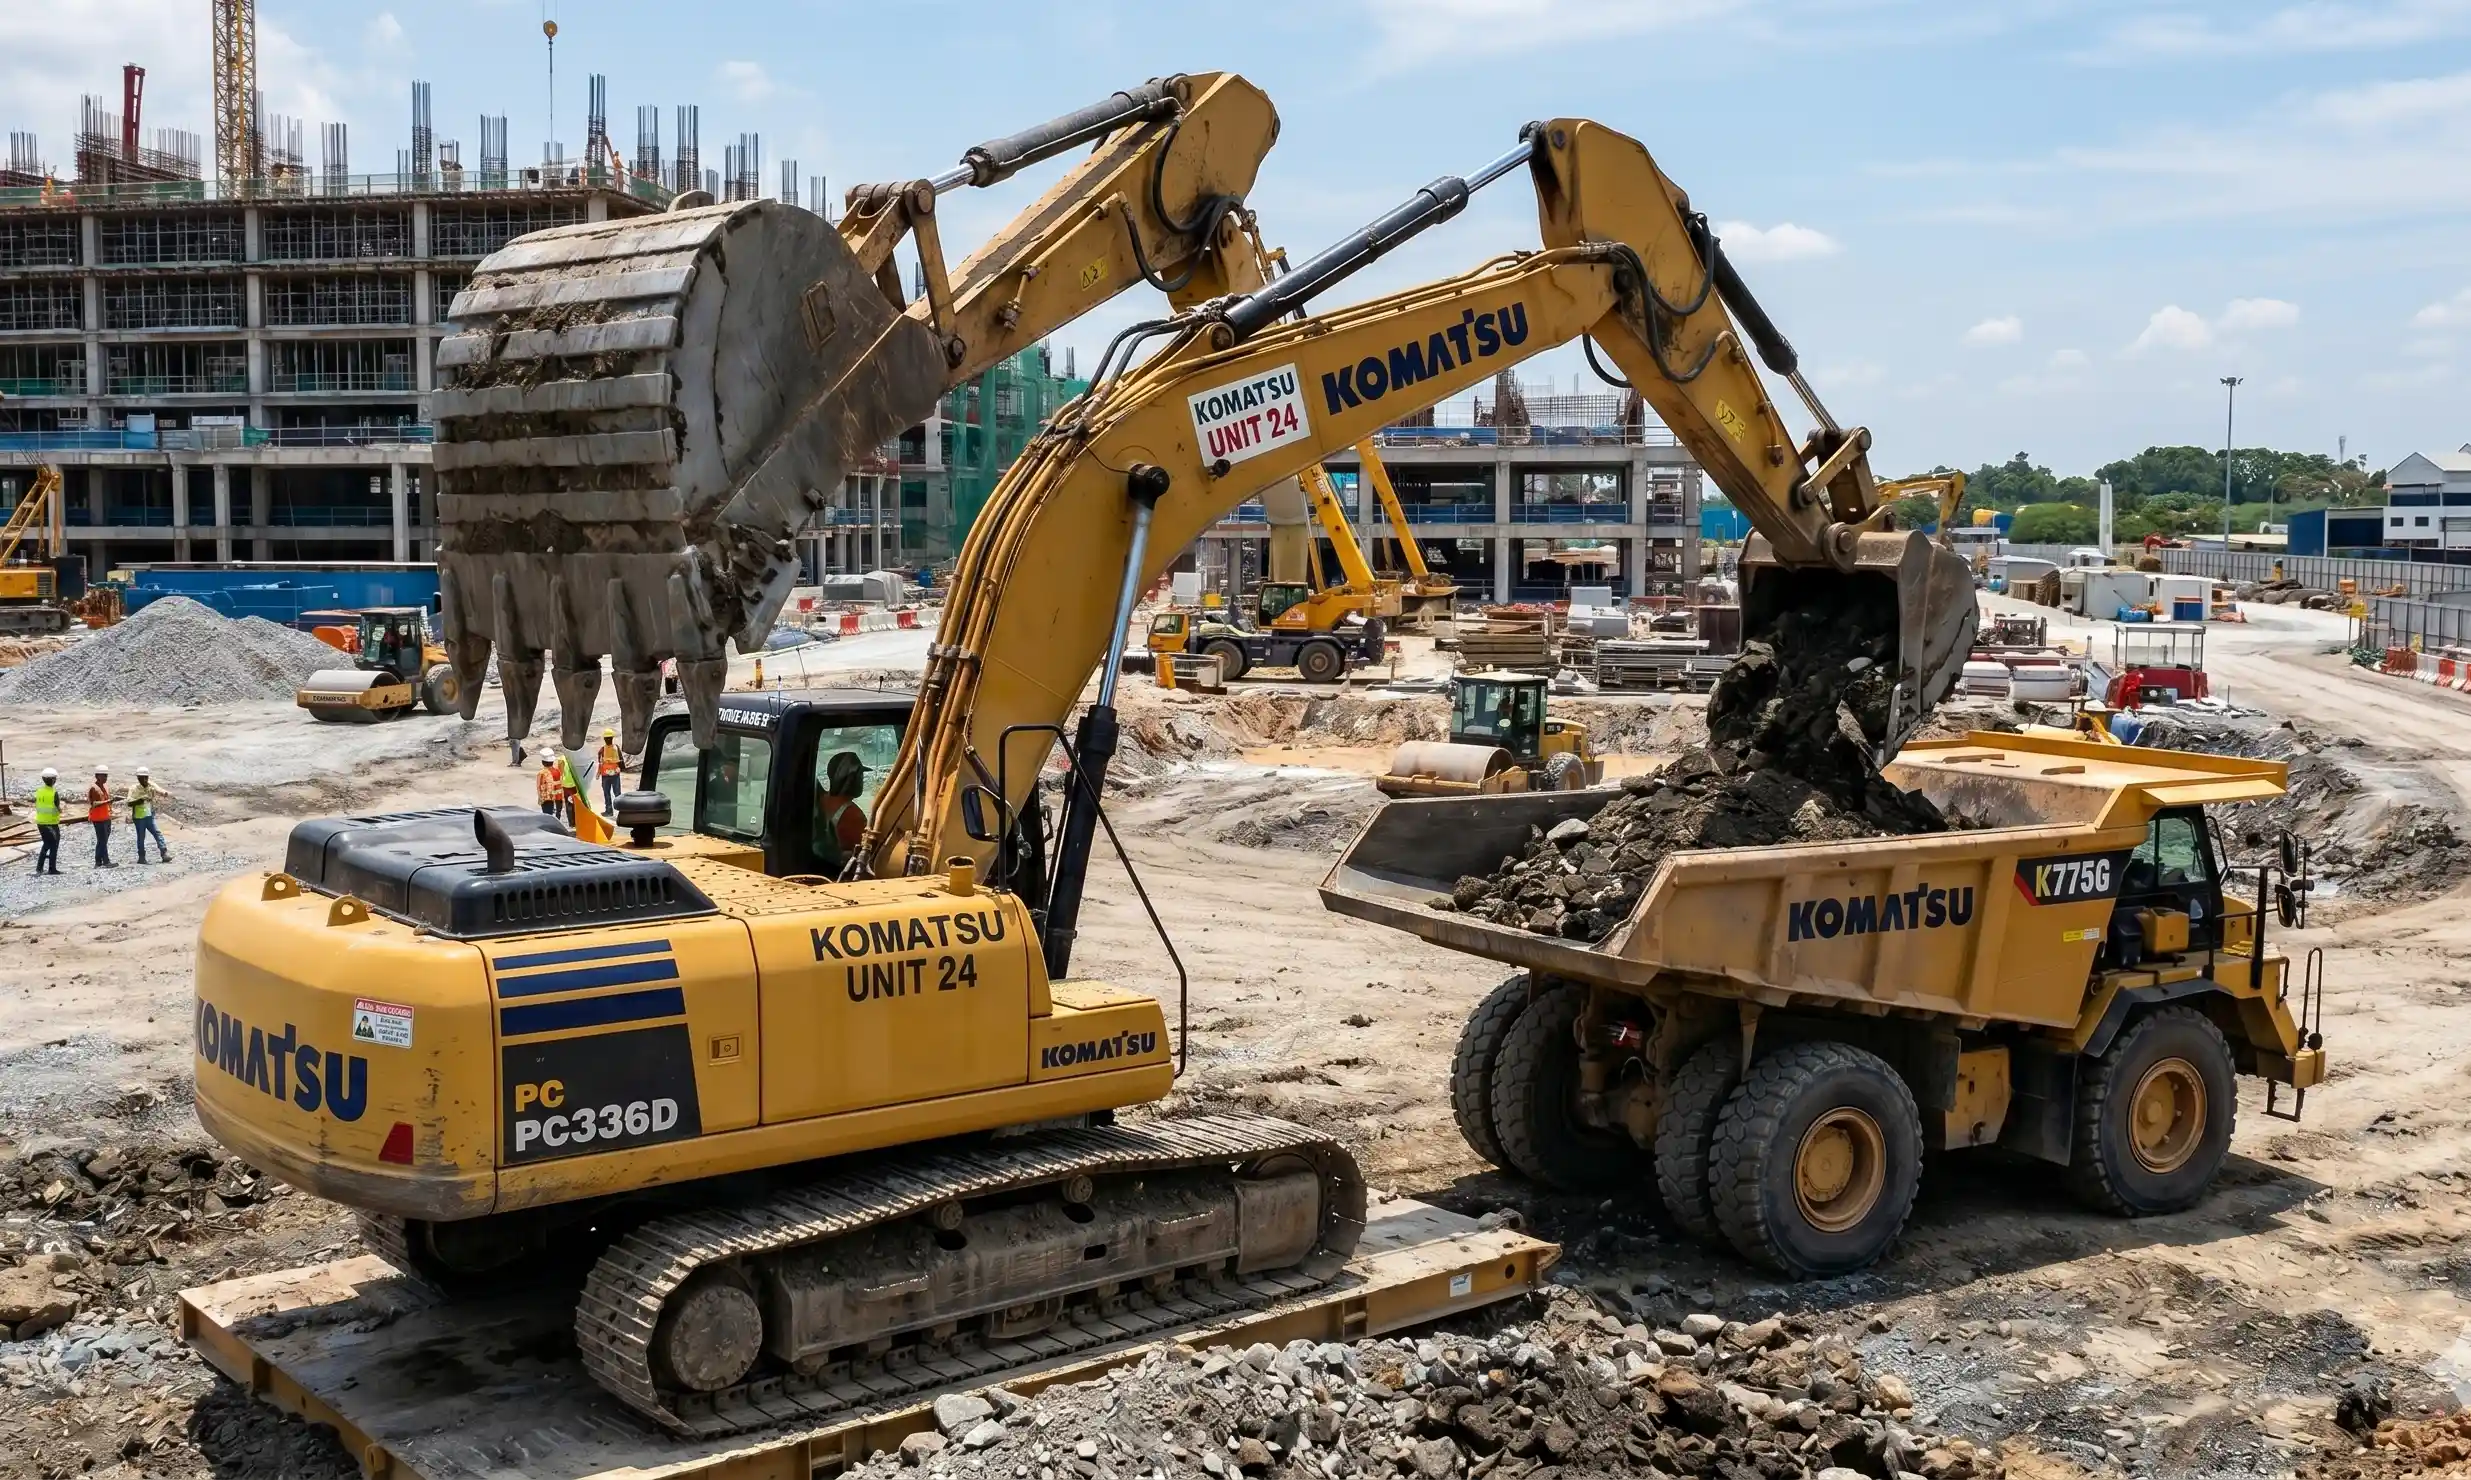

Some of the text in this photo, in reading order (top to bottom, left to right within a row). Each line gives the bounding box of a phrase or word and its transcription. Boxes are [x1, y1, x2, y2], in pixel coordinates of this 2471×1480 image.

[1321, 301, 1529, 416] KOMATSU
[1193, 371, 1296, 426] KOMATSU
[1207, 402, 1299, 458] UNIT 24
[2034, 858, 2111, 898] K775G
[809, 909, 1006, 962] KOMATSU
[1787, 882, 1974, 942] KOMATSU
[846, 953, 978, 1003] UNIT 24
[1041, 1029, 1157, 1069] KOMATSU
[514, 1079, 565, 1113] PC
[514, 1097, 679, 1152] PC336D
